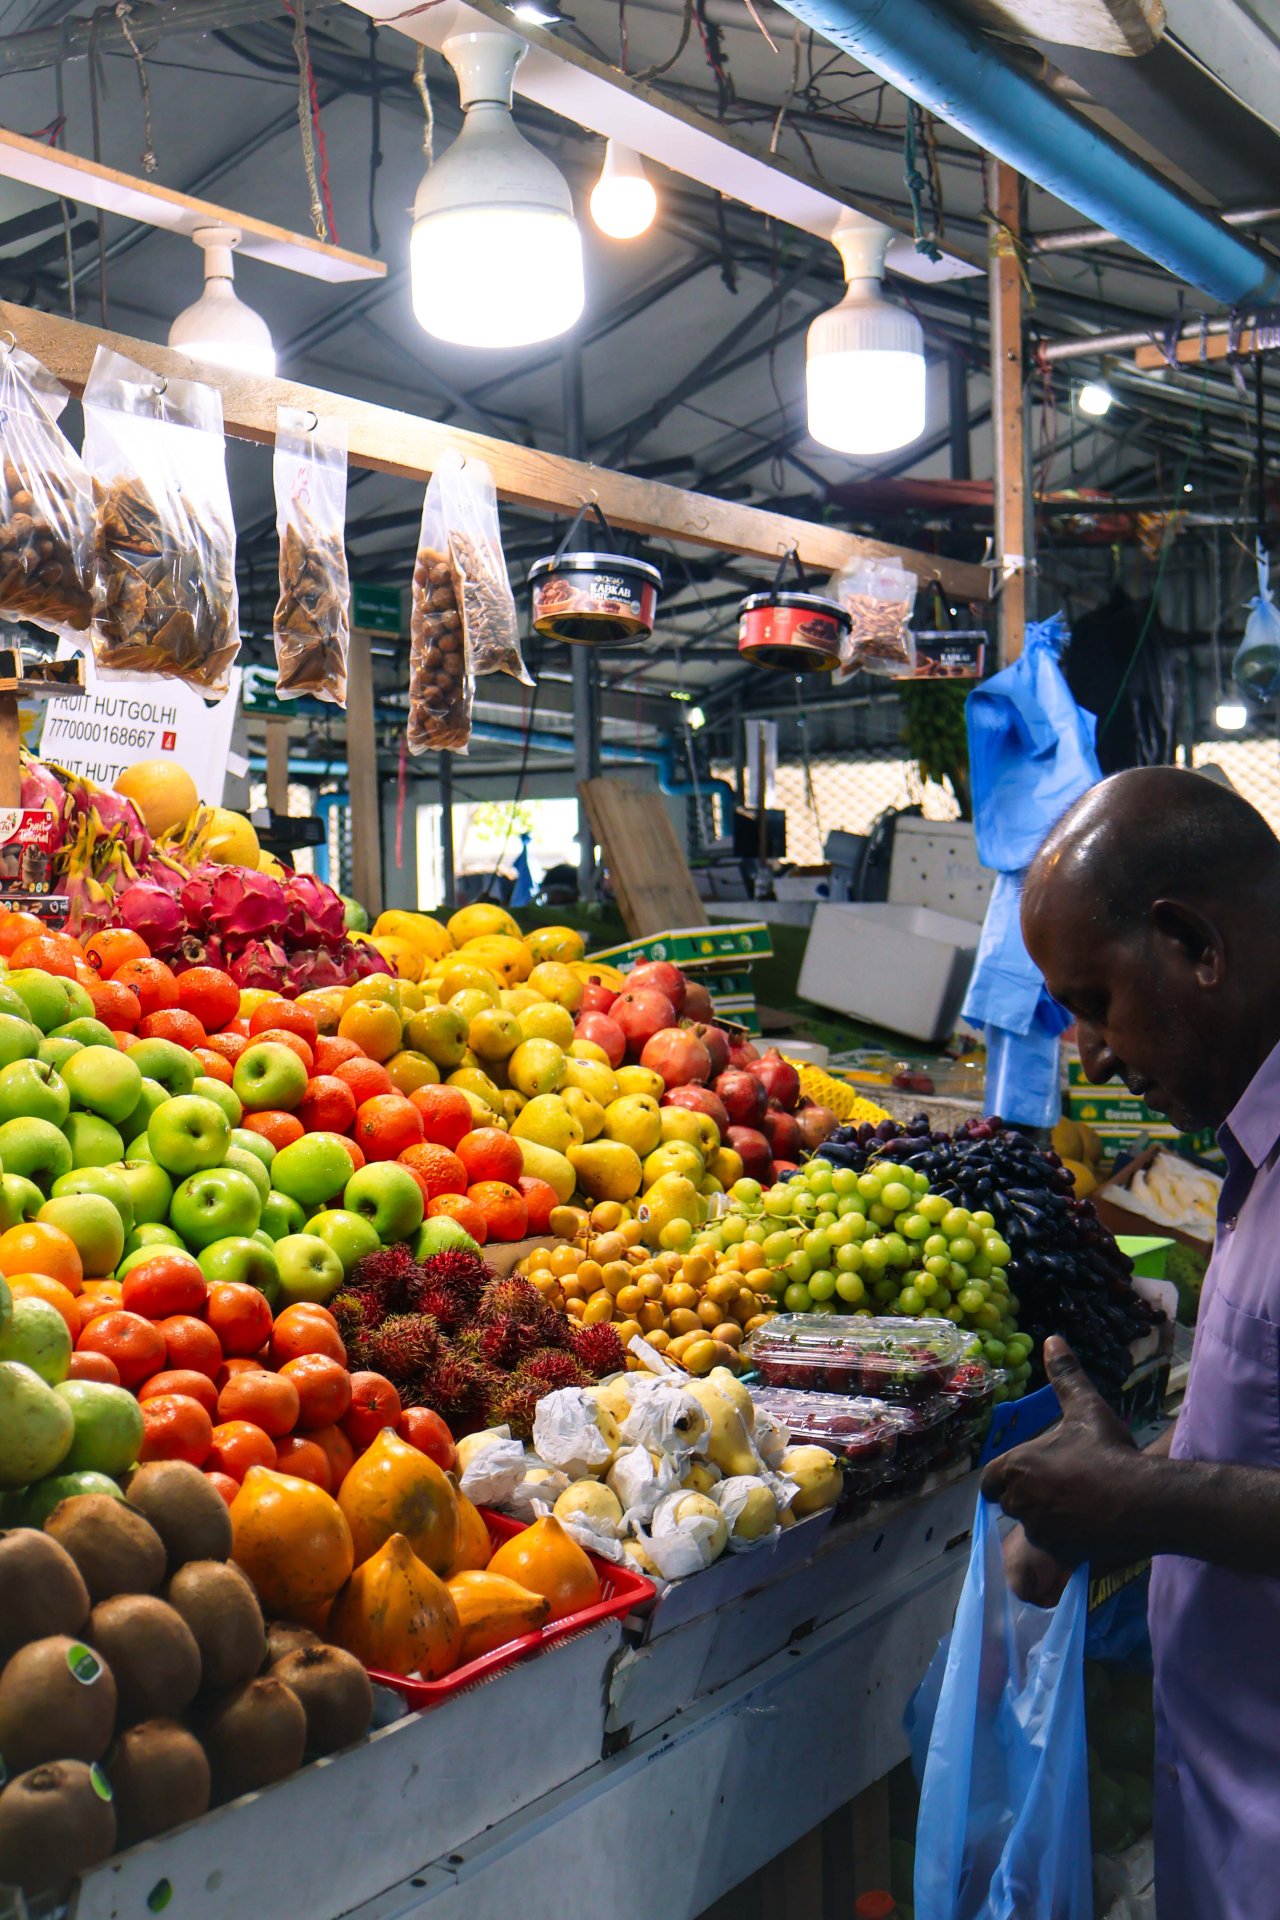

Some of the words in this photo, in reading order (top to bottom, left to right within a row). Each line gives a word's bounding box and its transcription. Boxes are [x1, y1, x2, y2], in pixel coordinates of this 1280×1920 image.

[590, 582, 632, 598] KABKAB
[94, 696, 177, 725] HUTGOLHI
[49, 718, 156, 748] 7770000168667
[1104, 1108, 1142, 1121] Guava
